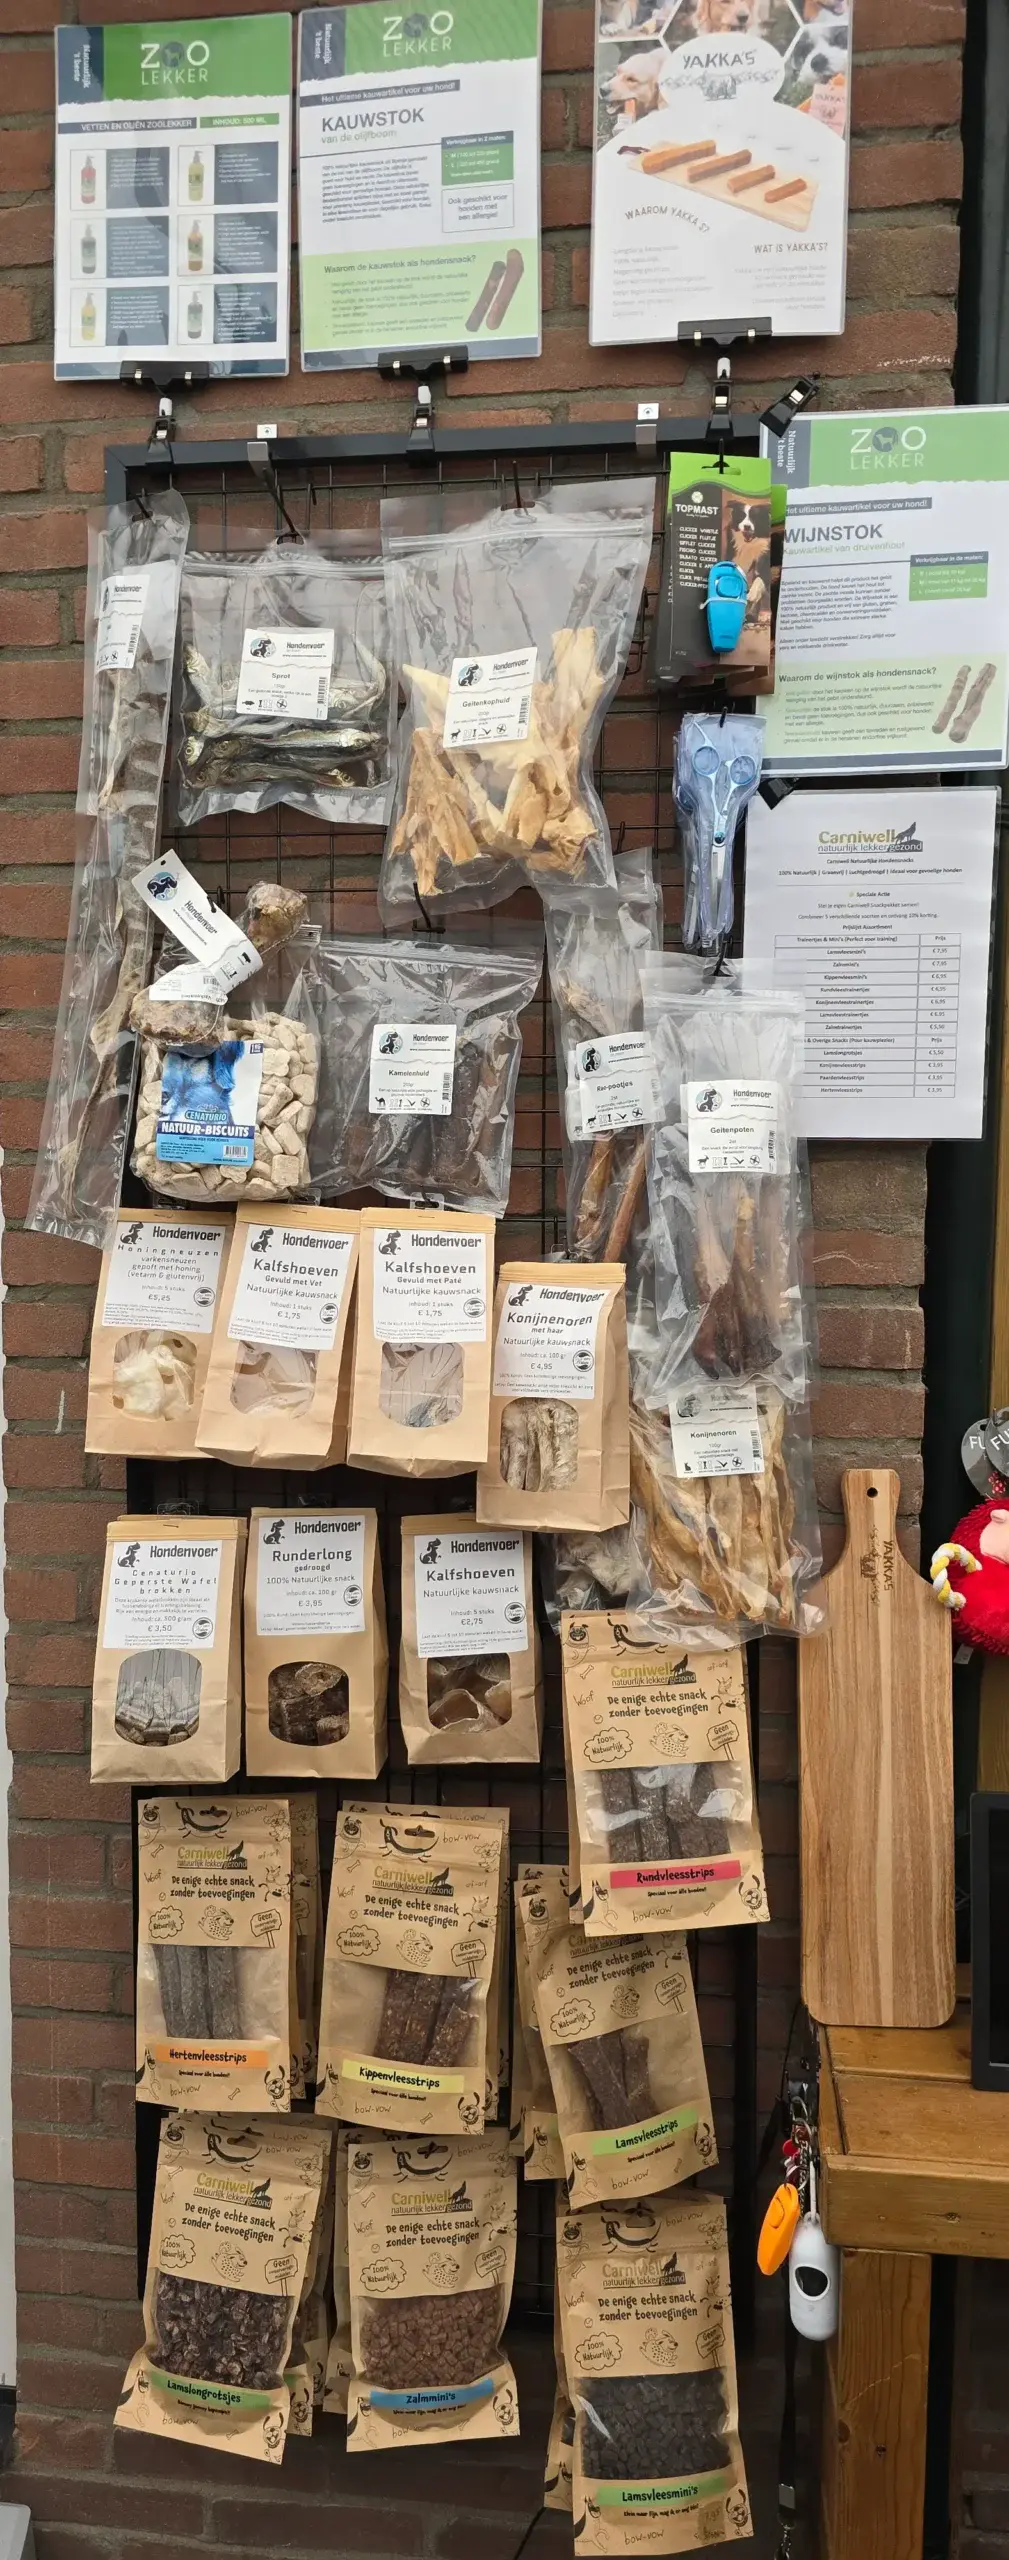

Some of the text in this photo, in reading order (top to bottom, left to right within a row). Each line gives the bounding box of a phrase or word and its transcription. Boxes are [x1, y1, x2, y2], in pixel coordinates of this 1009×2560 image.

[383, 37, 451, 57] LEKKER
[682, 50, 756, 69] YAKKA'S
[141, 68, 208, 85] LEKKER
[81, 122, 109, 132] VETTEN
[111, 122, 122, 130] EN
[147, 119, 192, 129] ZOOLEKKER
[322, 108, 424, 133] KAUWSTOK
[321, 129, 397, 143] van de olijfboom
[625, 205, 668, 220] WAAROM
[754, 242, 828, 253] WAT IS YAKKA'S?
[324, 254, 476, 274] Waarom de kauwstok als hondensnack?
[786, 431, 796, 474] Natuurlijk
[850, 453, 925, 470] LEKKER
[675, 503, 719, 515] TOPMAST
[799, 505, 826, 514] ultieme
[828, 503, 871, 511] kauwartikel
[784, 524, 883, 543] WIJNSTOK
[287, 641, 325, 649] Hondenvoer
[493, 658, 528, 670] Hondenvoer
[779, 666, 936, 683] Waarom de wijnstok als hondensnack?
[462, 696, 510, 708] Geitenkophuid
[819, 830, 896, 844] Carniwell
[818, 844, 858, 852] natuurlijk
[889, 843, 921, 852] gezond
[184, 900, 217, 935] Hondenvoer
[413, 1034, 449, 1042] Hondenvoer
[609, 1042, 646, 1052] Hondenvoer
[733, 1089, 772, 1098] Hondenvoer
[185, 1110, 226, 1122] CENATURIO
[161, 1122, 250, 1137] NATUUR-BISCUITS
[711, 1126, 754, 1134] Geitenpoten
[153, 1226, 220, 1241] Hondenvoer
[283, 1233, 349, 1251] Hondenvoer
[411, 1234, 481, 1248] Hondenvoer
[141, 1256, 197, 1265] varkensneuzen
[253, 1259, 339, 1277] Kalfshoeven
[385, 1262, 476, 1274] Kalfshoeven
[128, 1271, 155, 1279] (vetarm
[166, 1273, 205, 1282] glutenvrij)
[265, 1275, 290, 1283] Gevuld
[397, 1276, 424, 1284] Gevuld
[444, 1276, 461, 1284] Paté
[247, 1284, 338, 1299] Natuurlijke kauwsnack
[383, 1286, 481, 1295] Natuurlijke kauwsnack
[539, 1288, 604, 1302] Hondenvoer
[507, 1312, 592, 1326] Konijnenoren
[504, 1337, 591, 1346] Natuurlijke kauwsnack
[538, 1362, 552, 1370] 4,95
[691, 1430, 736, 1438] Konijnenoren
[294, 1520, 361, 1535] Hondenvoer
[150, 1545, 218, 1558] Hondenvoer
[451, 1539, 519, 1554] Hondenvoer
[273, 1548, 352, 1563] Runderlong
[294, 1564, 331, 1572] gedroogd
[883, 1540, 894, 1591] YAKKA'S
[115, 1578, 173, 1586] Geperste
[291, 1576, 332, 1584] Natuurlijke
[334, 1574, 355, 1582] snack
[427, 1568, 515, 1582] Kalfshoeven
[423, 1585, 519, 1598] Natuurlijke kauwsnack
[611, 1662, 672, 1678] Carniwell
[573, 1692, 594, 1706] Woof
[607, 1689, 707, 1707] De enige echte snack
[609, 1703, 708, 1718] zonder toevoegingen
[713, 1724, 729, 1735] Geen
[597, 1735, 614, 1744] 100%
[592, 1743, 624, 1755] Natuurlijk
[178, 1846, 229, 1861] Carniwell
[172, 1875, 254, 1887] De enige echte snack
[374, 1865, 433, 1883] Carniwell
[637, 1866, 714, 1883] Rundvleesstrips
[170, 1889, 255, 1900] zonder toevoegingen
[364, 1908, 459, 1927] zonder toevoegingen
[633, 1905, 673, 1922] bow-vow
[569, 1960, 655, 1989] zonder toevoegingen
[170, 2049, 247, 2062] Hertenvleesstrips
[359, 2066, 440, 2088] Kippenvleesstrips
[615, 2120, 678, 2149] Lamsvleesstrips
[197, 2172, 253, 2195] Carniwell
[392, 2190, 451, 2205] Carniwell
[182, 2217, 274, 2243] zonder toevoegingen
[386, 2232, 480, 2248] zonder toevoegingen
[602, 2262, 662, 2277] Carniwell
[599, 2307, 698, 2320] zonder toevoegingen
[167, 2379, 241, 2404] Lamslongrotsjes
[406, 2392, 456, 2404] Zalmmini's
[622, 2486, 698, 2502] Lamsvleesmini's
